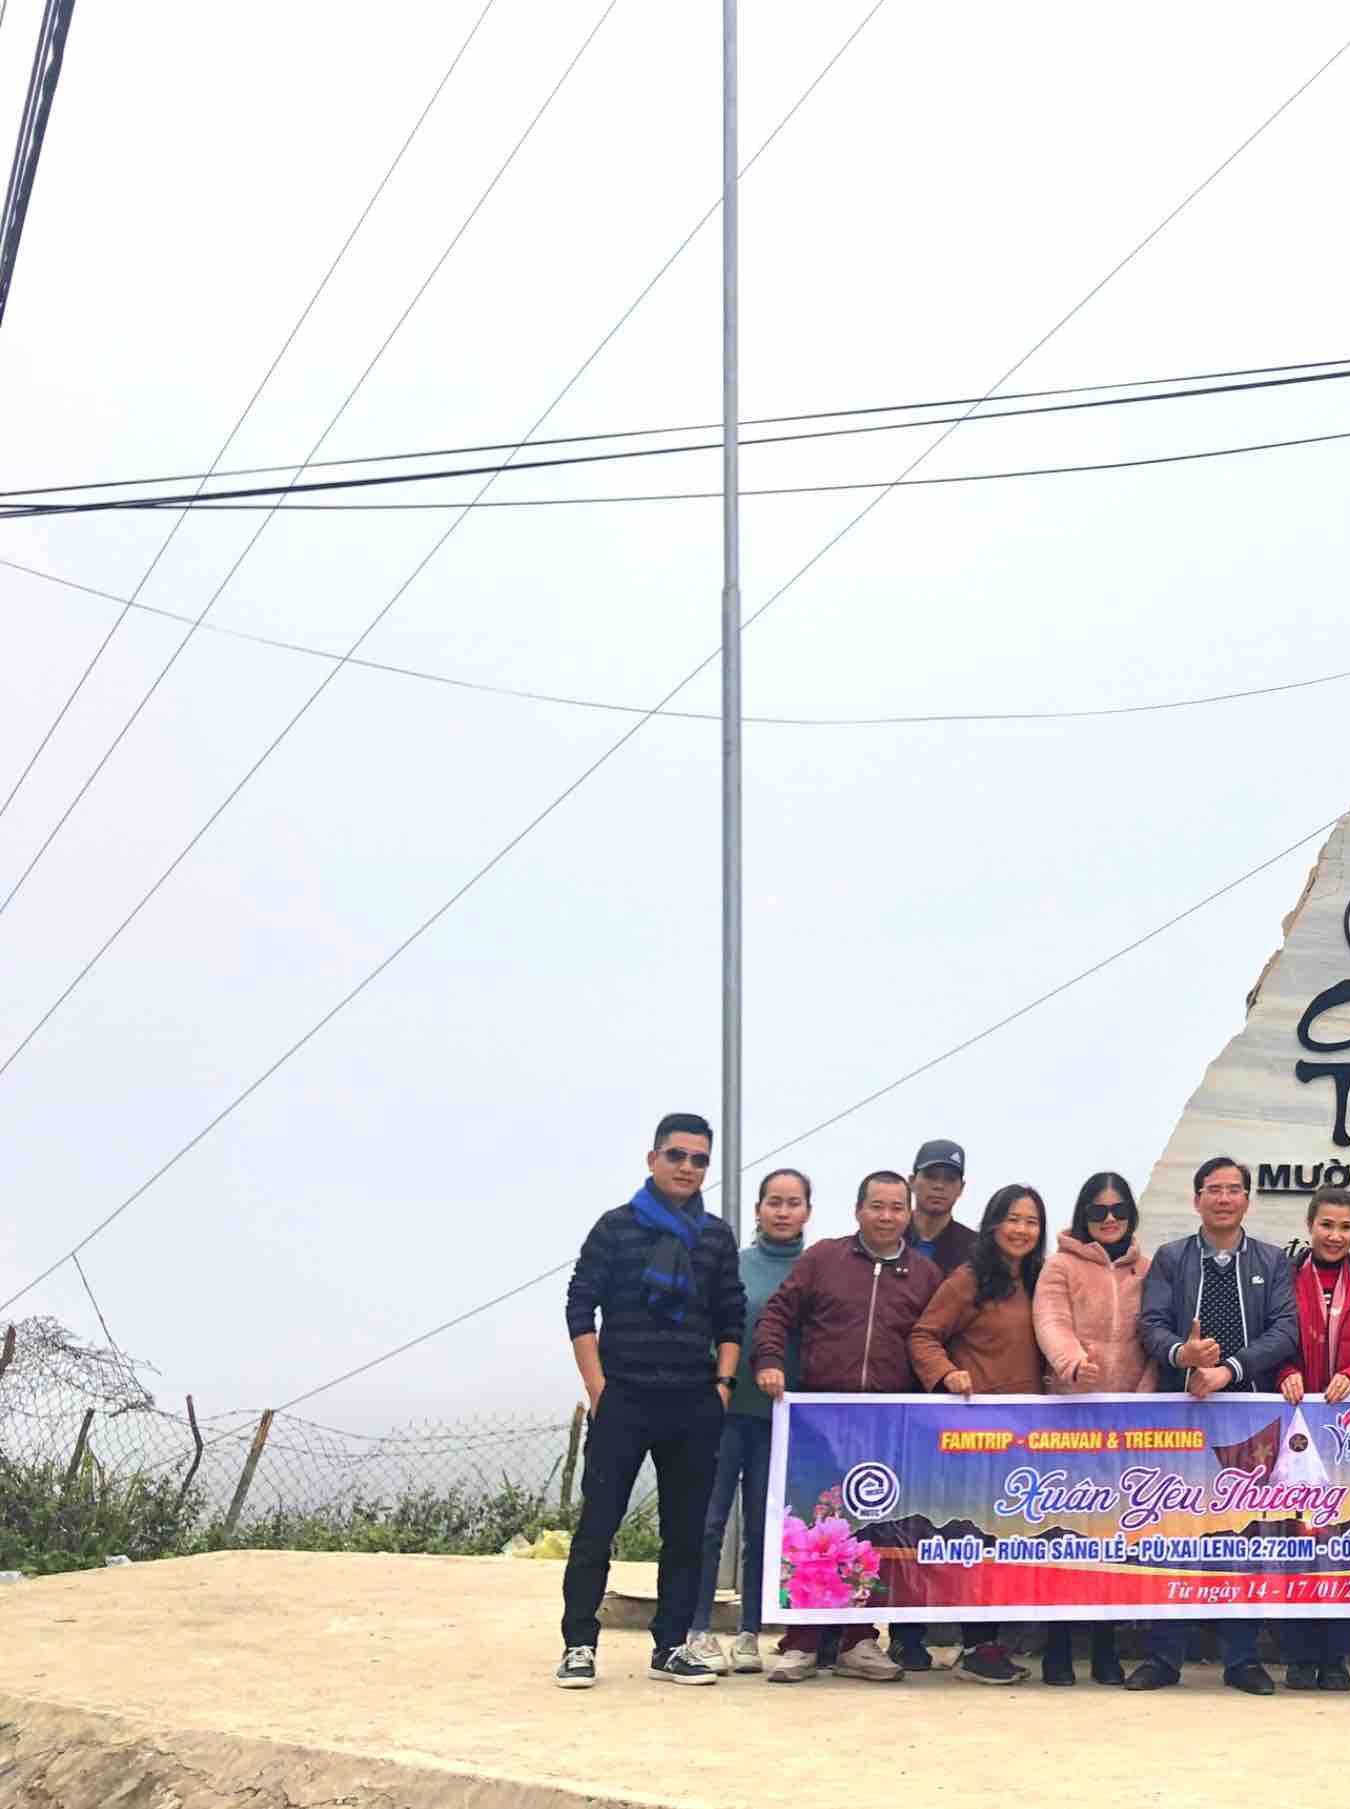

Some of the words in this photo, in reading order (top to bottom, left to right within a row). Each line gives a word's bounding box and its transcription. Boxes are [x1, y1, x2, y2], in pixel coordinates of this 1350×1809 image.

[941, 1431, 1013, 1450] FAMTRIP
[1028, 1431, 1101, 1450] CARAVAN
[1106, 1431, 1120, 1450] &
[1124, 1430, 1204, 1450] TREKKING
[996, 1467, 1118, 1521] Xuân
[1120, 1467, 1205, 1529] Yêu
[1210, 1465, 1348, 1526] Thương
[920, 1536, 945, 1561] HÀ
[950, 1536, 982, 1567] NỘI
[998, 1537, 1048, 1561] RỪNG
[1141, 1534, 1165, 1560] PÙ
[1168, 1538, 1198, 1560] XAI
[1203, 1538, 1247, 1560] LENG
[1168, 1581, 1193, 1599] Từ
[1198, 1582, 1241, 1603] ngày
[1247, 1582, 1267, 1598] 14
[1286, 1581, 1306, 1598] 17
